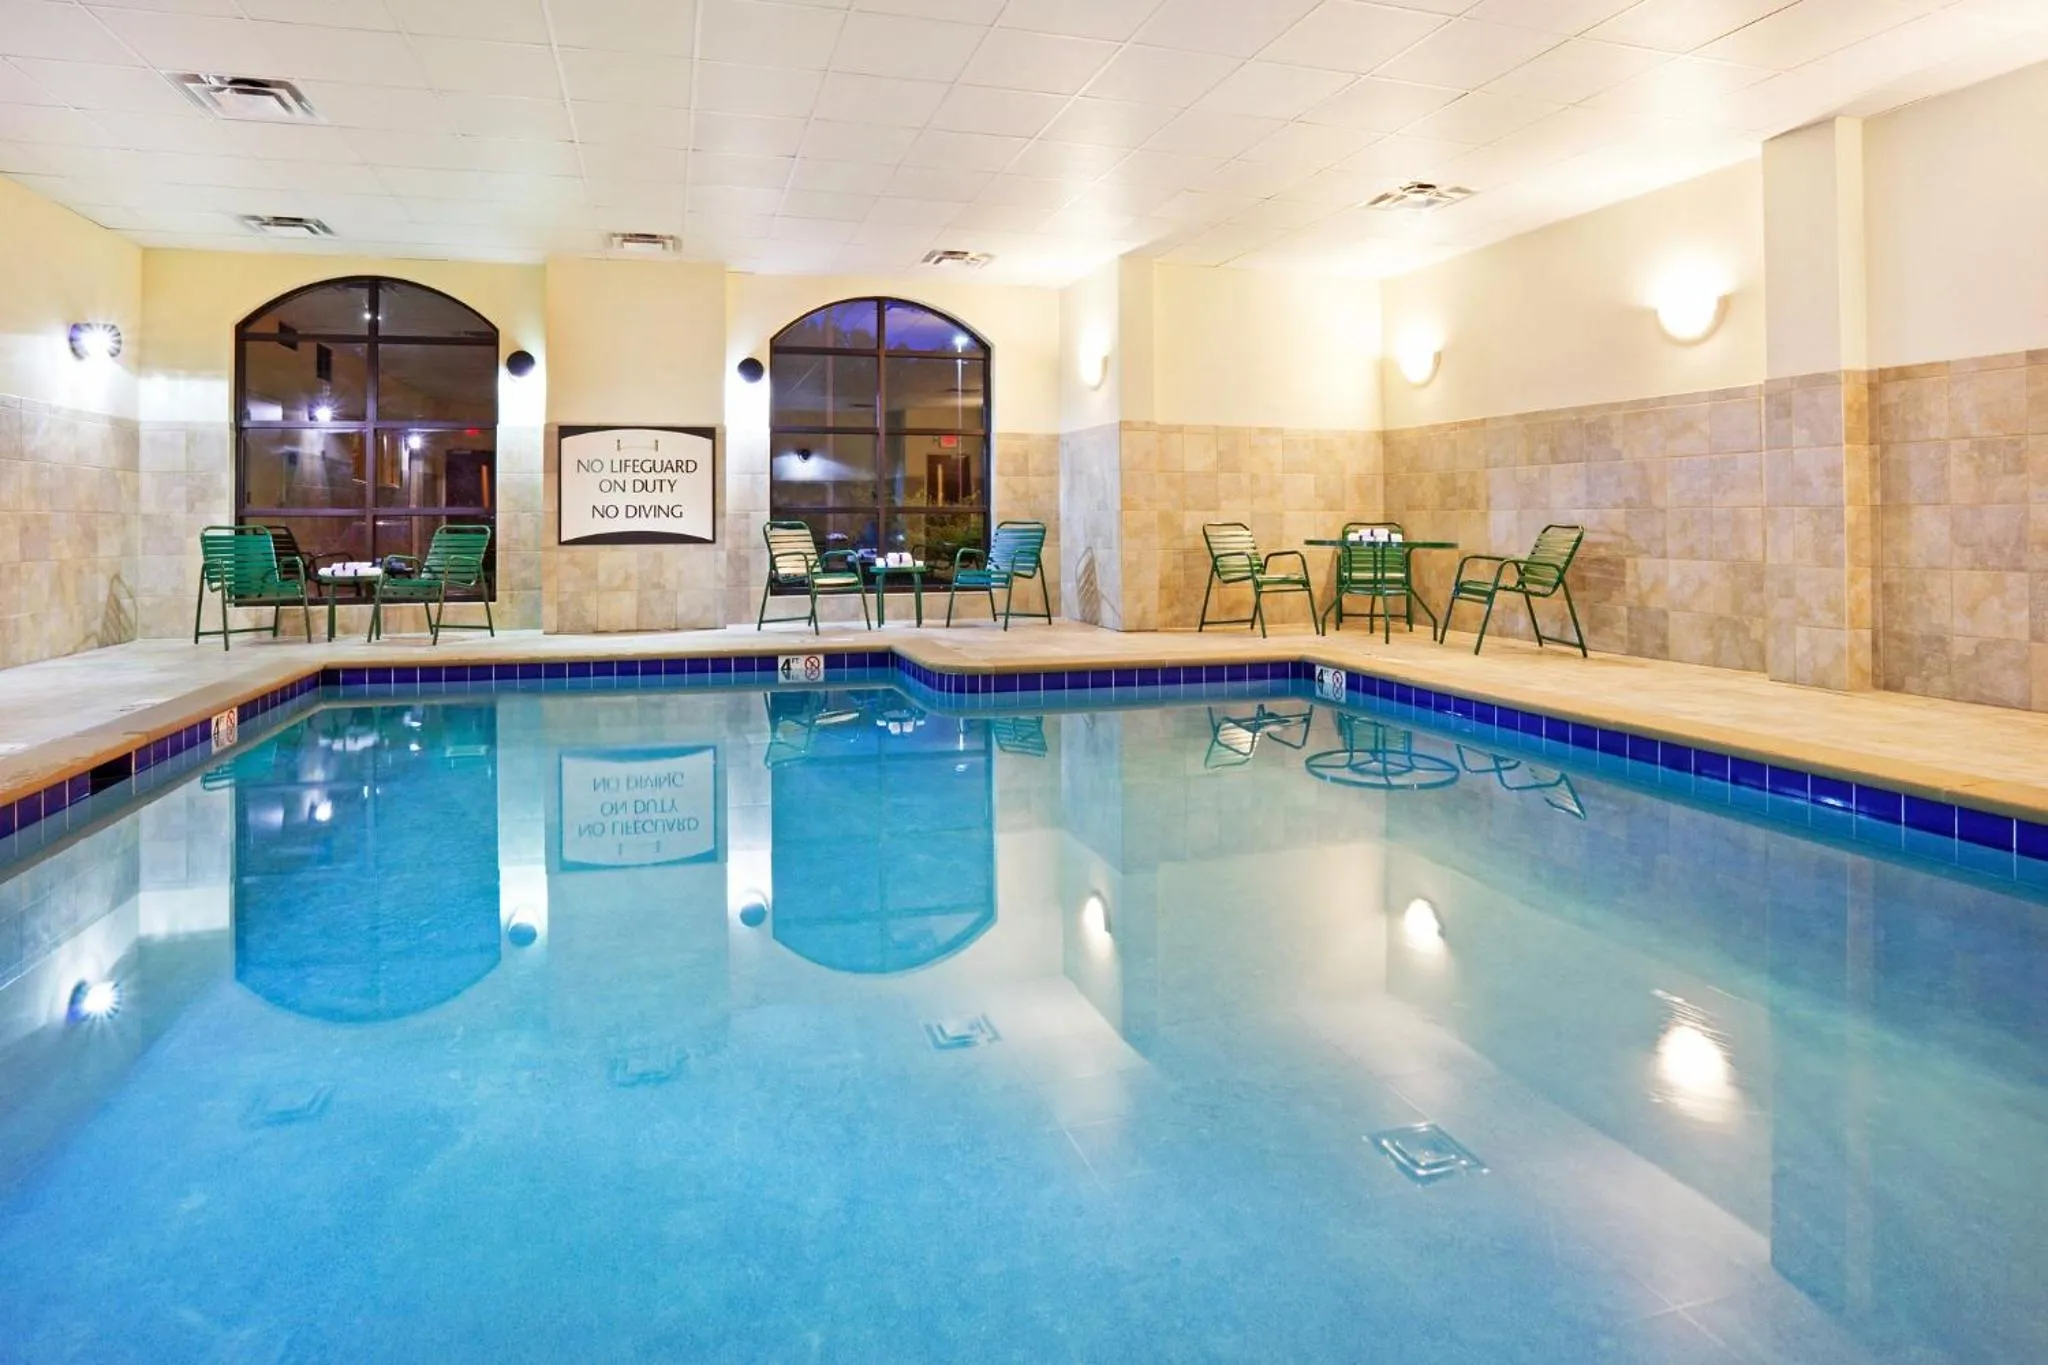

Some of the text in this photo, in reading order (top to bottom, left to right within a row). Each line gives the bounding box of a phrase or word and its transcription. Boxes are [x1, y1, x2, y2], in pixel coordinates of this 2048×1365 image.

[577, 459, 697, 473] NO LIFEGUARD
[599, 479, 677, 493] ON DUTY
[592, 504, 683, 519] NO DIVING
[781, 658, 791, 671] 4
